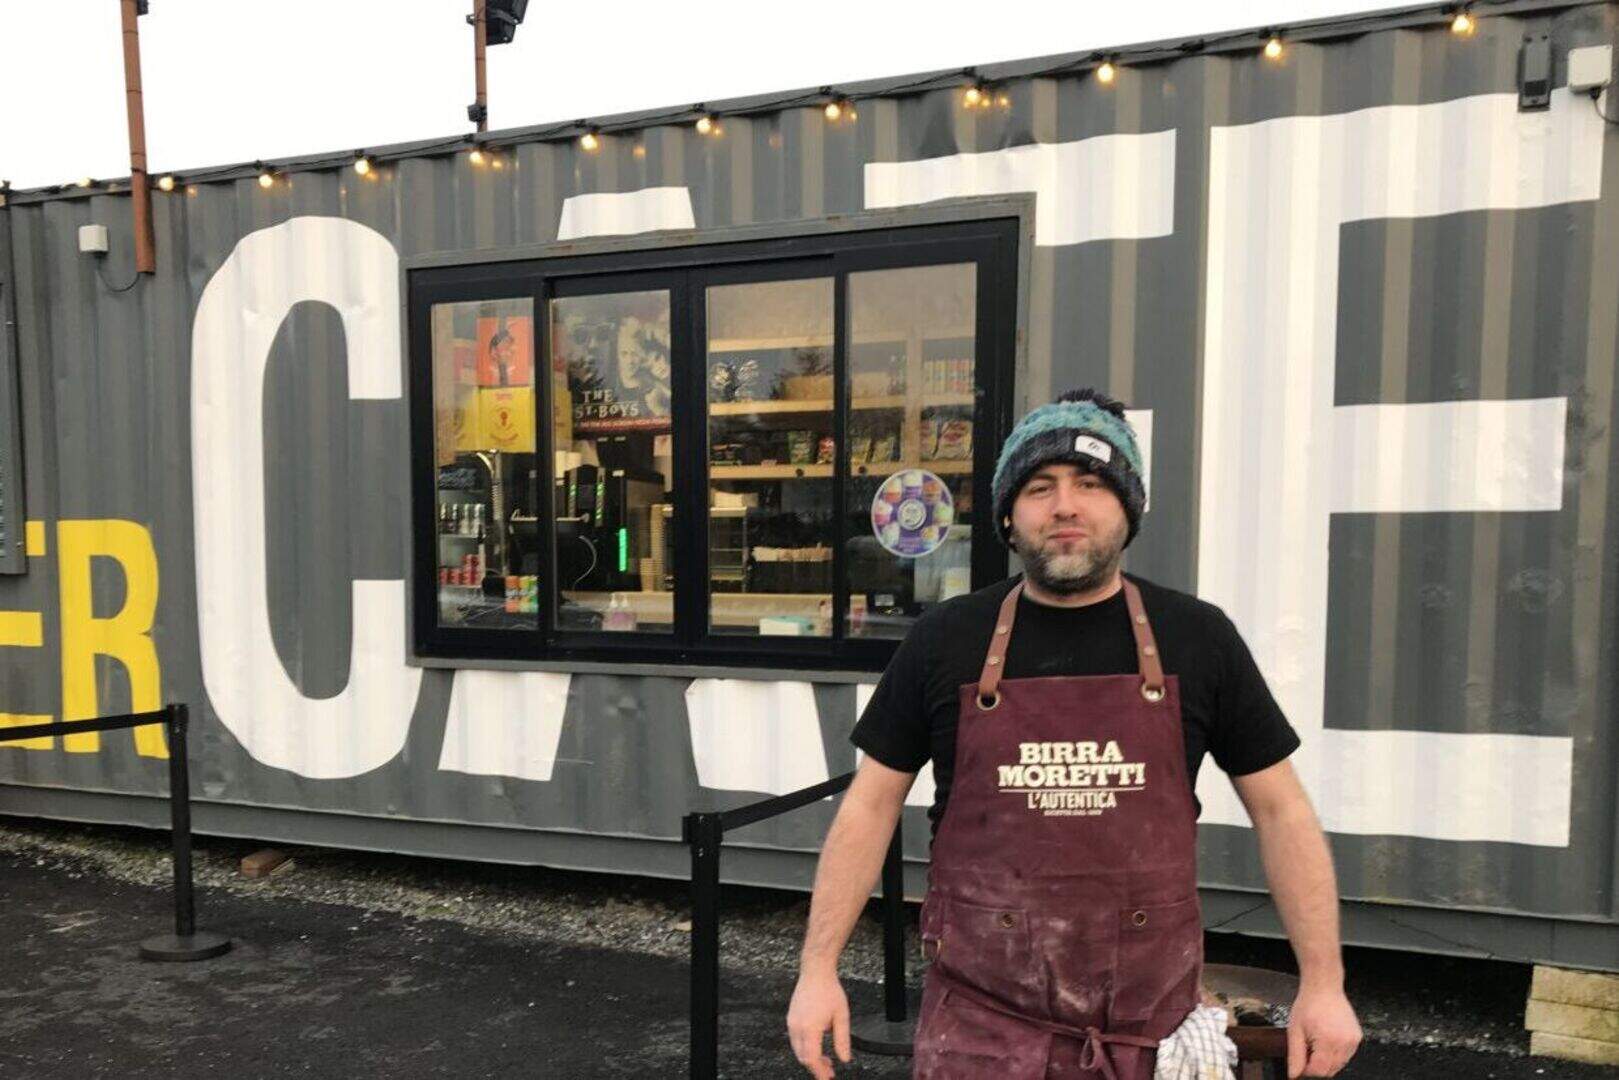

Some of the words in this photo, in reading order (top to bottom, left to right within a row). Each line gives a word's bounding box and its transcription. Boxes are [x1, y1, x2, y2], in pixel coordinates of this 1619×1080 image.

[582, 389, 614, 403] THE
[191, 92, 1606, 847] CE
[1019, 741, 1124, 764] BIRRA
[997, 762, 1146, 787] MORETTI
[1027, 792, 1117, 809] L'AUTENTICA
